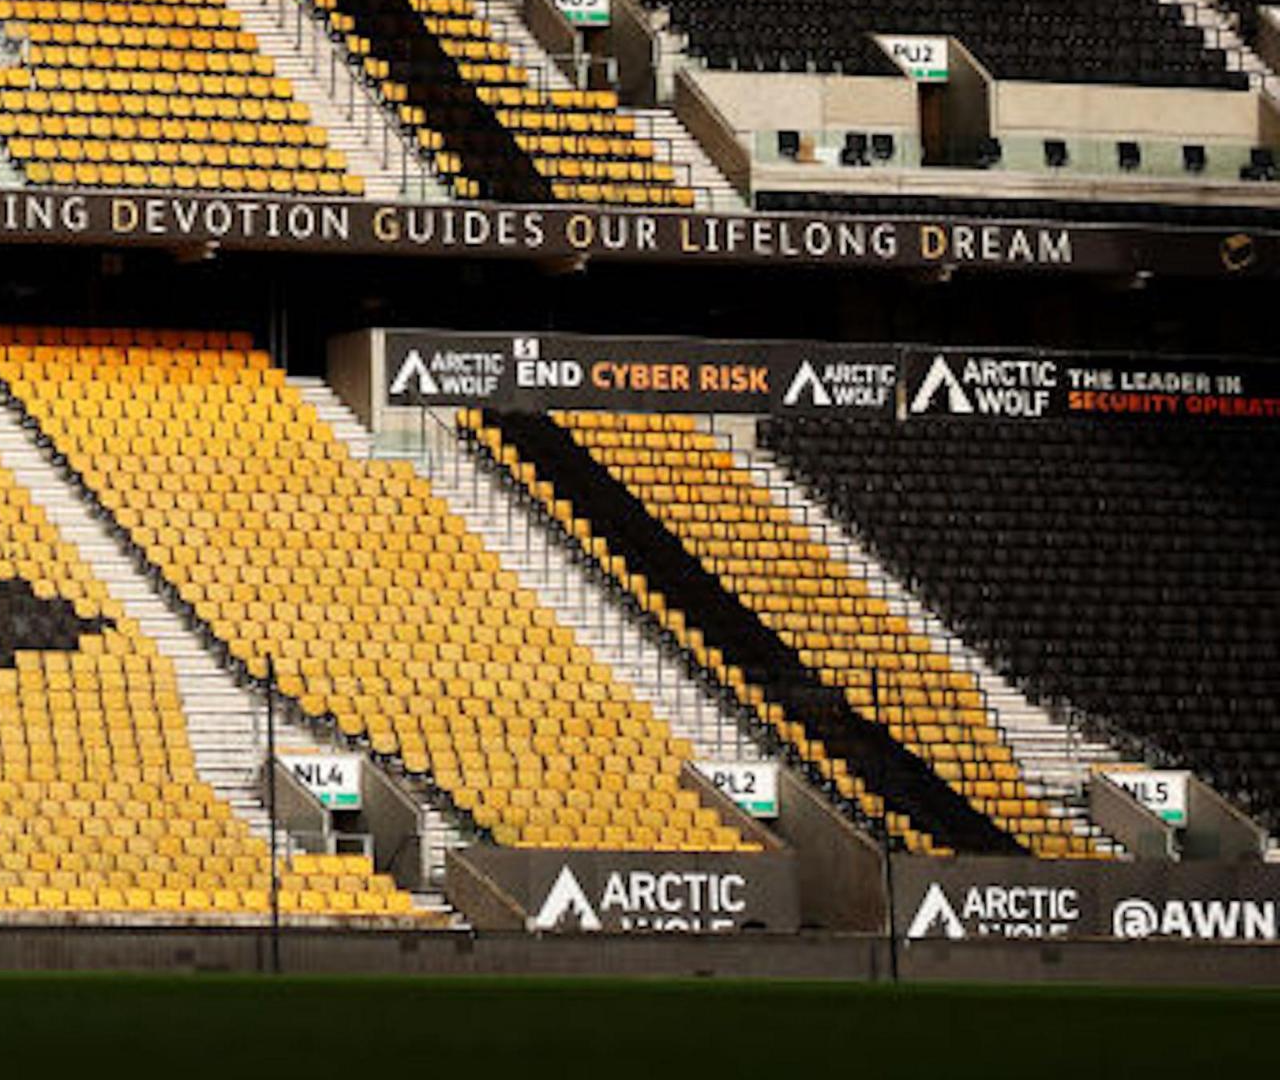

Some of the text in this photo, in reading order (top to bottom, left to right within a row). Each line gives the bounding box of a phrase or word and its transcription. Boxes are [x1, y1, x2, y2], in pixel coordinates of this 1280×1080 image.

[894, 44, 932, 62] PU2
[111, 197, 349, 240] DEVOTION
[373, 206, 545, 247] GUIDES
[566, 214, 656, 249] OUR
[681, 217, 897, 258] LIFELONG
[920, 225, 1072, 263] DREAM
[432, 352, 504, 375] ARCTIC
[822, 364, 895, 384] ARCTIC
[963, 360, 1057, 387] ARCTIC
[441, 376, 498, 395] WOLF
[517, 360, 770, 393] END CYBER RISK
[1068, 369, 1242, 394] THE LEADER IN
[831, 387, 888, 406] WOLF
[974, 388, 1049, 417] WOLF
[1068, 390, 1180, 413] SECURITY
[295, 764, 343, 786] NL4
[713, 772, 755, 793] PL2
[600, 872, 746, 912] ARCTIC
[963, 886, 1079, 920] ARCTIC
[1113, 900, 1277, 939] @AWN
